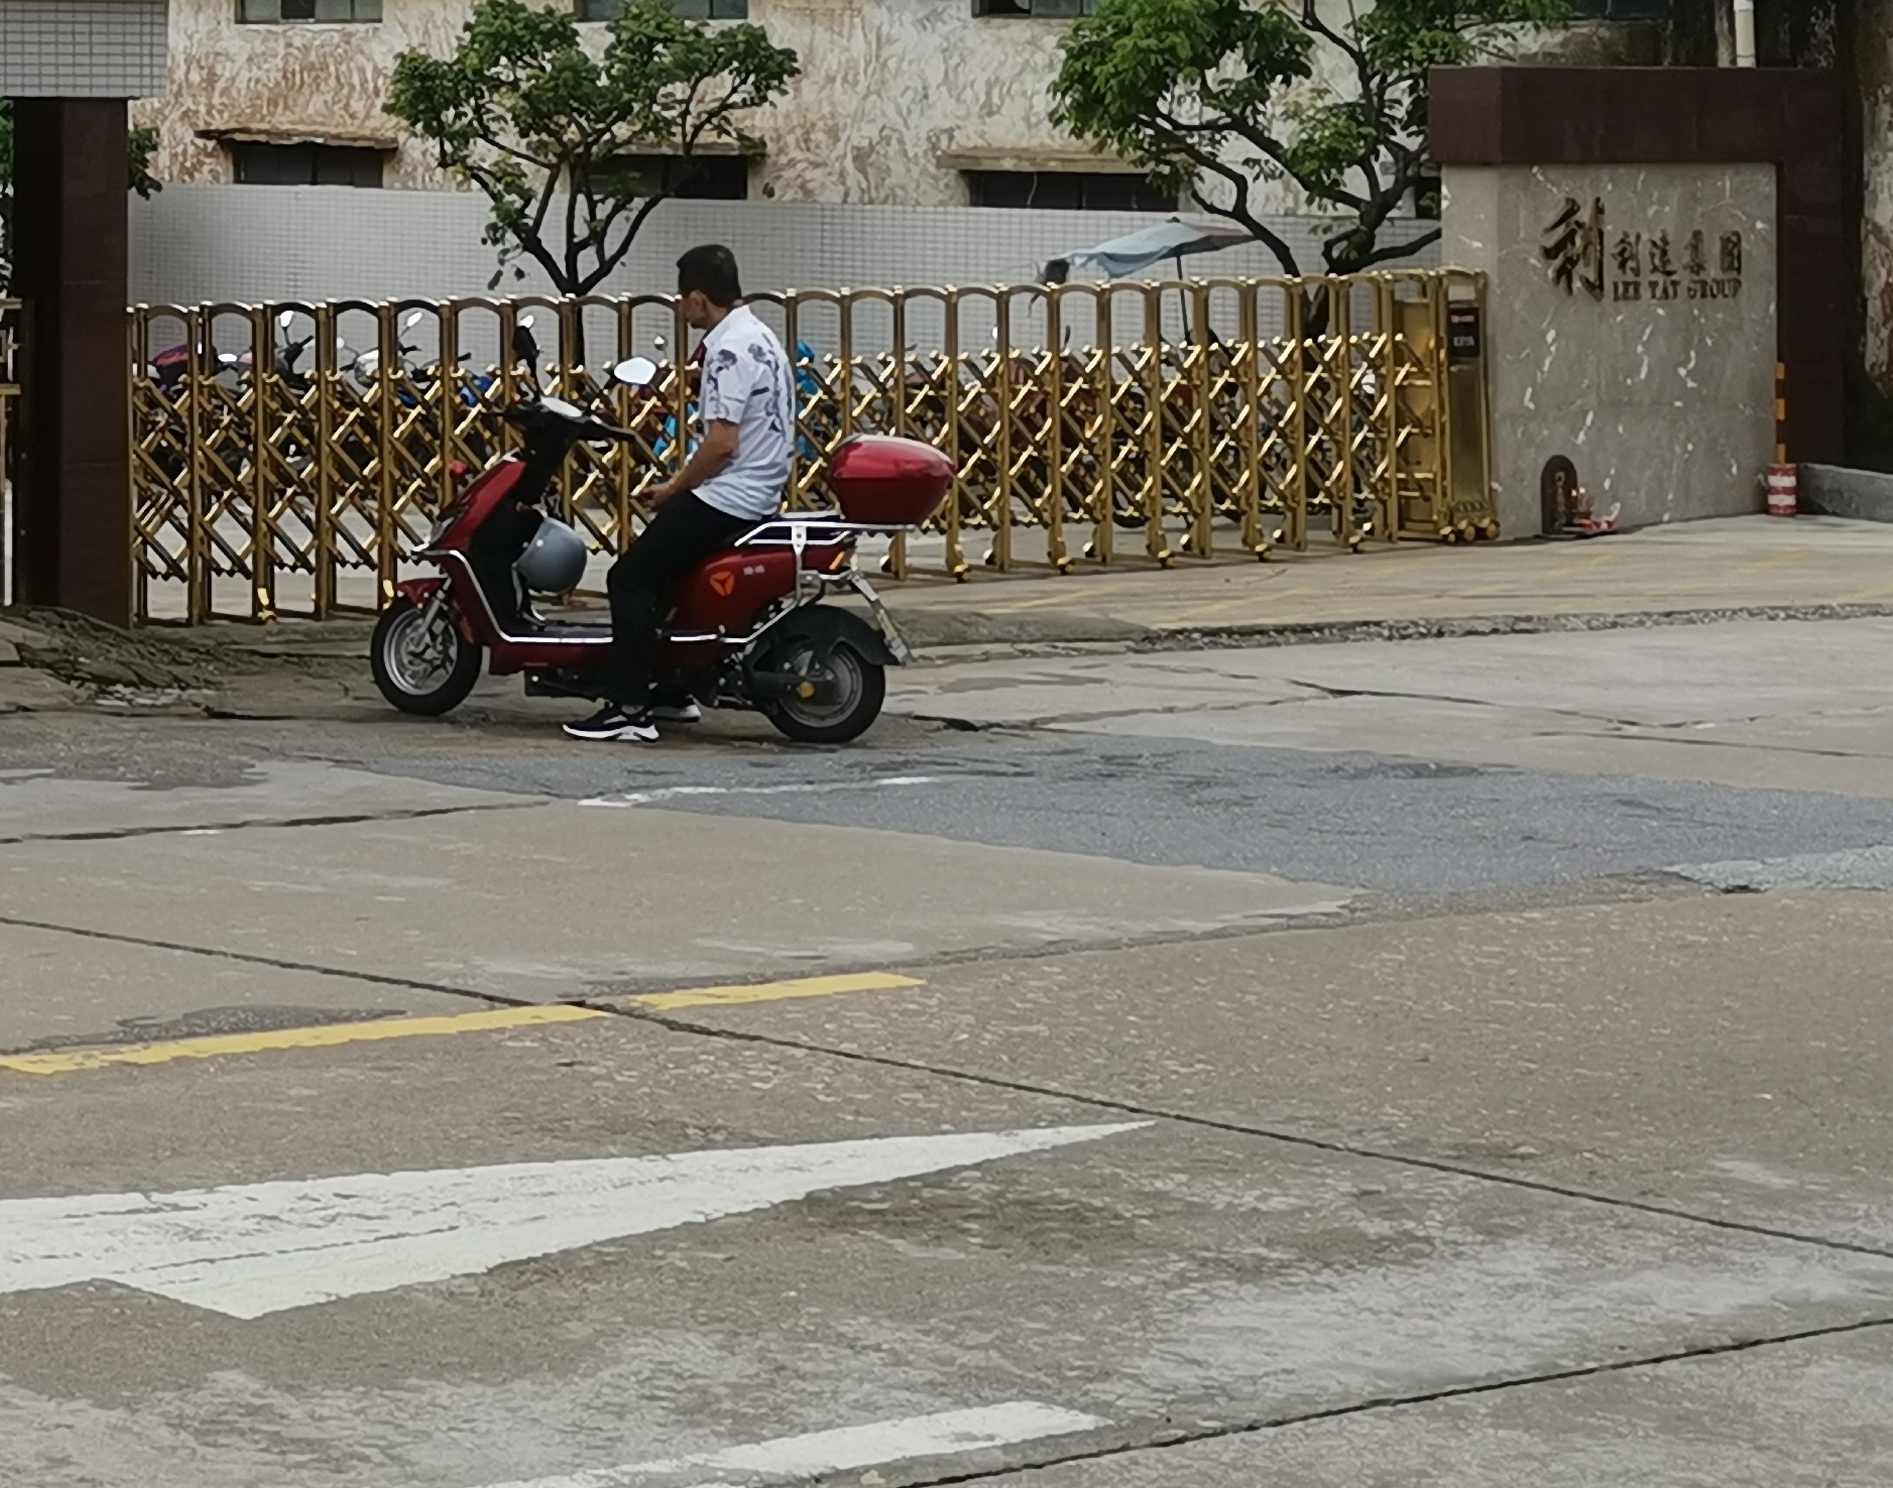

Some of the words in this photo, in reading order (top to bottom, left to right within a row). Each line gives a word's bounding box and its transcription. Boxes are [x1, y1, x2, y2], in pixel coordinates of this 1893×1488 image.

[1613, 280, 1641, 302] LEE
[1648, 279, 1681, 301] TAT
[1687, 277, 1742, 299] GROUP
